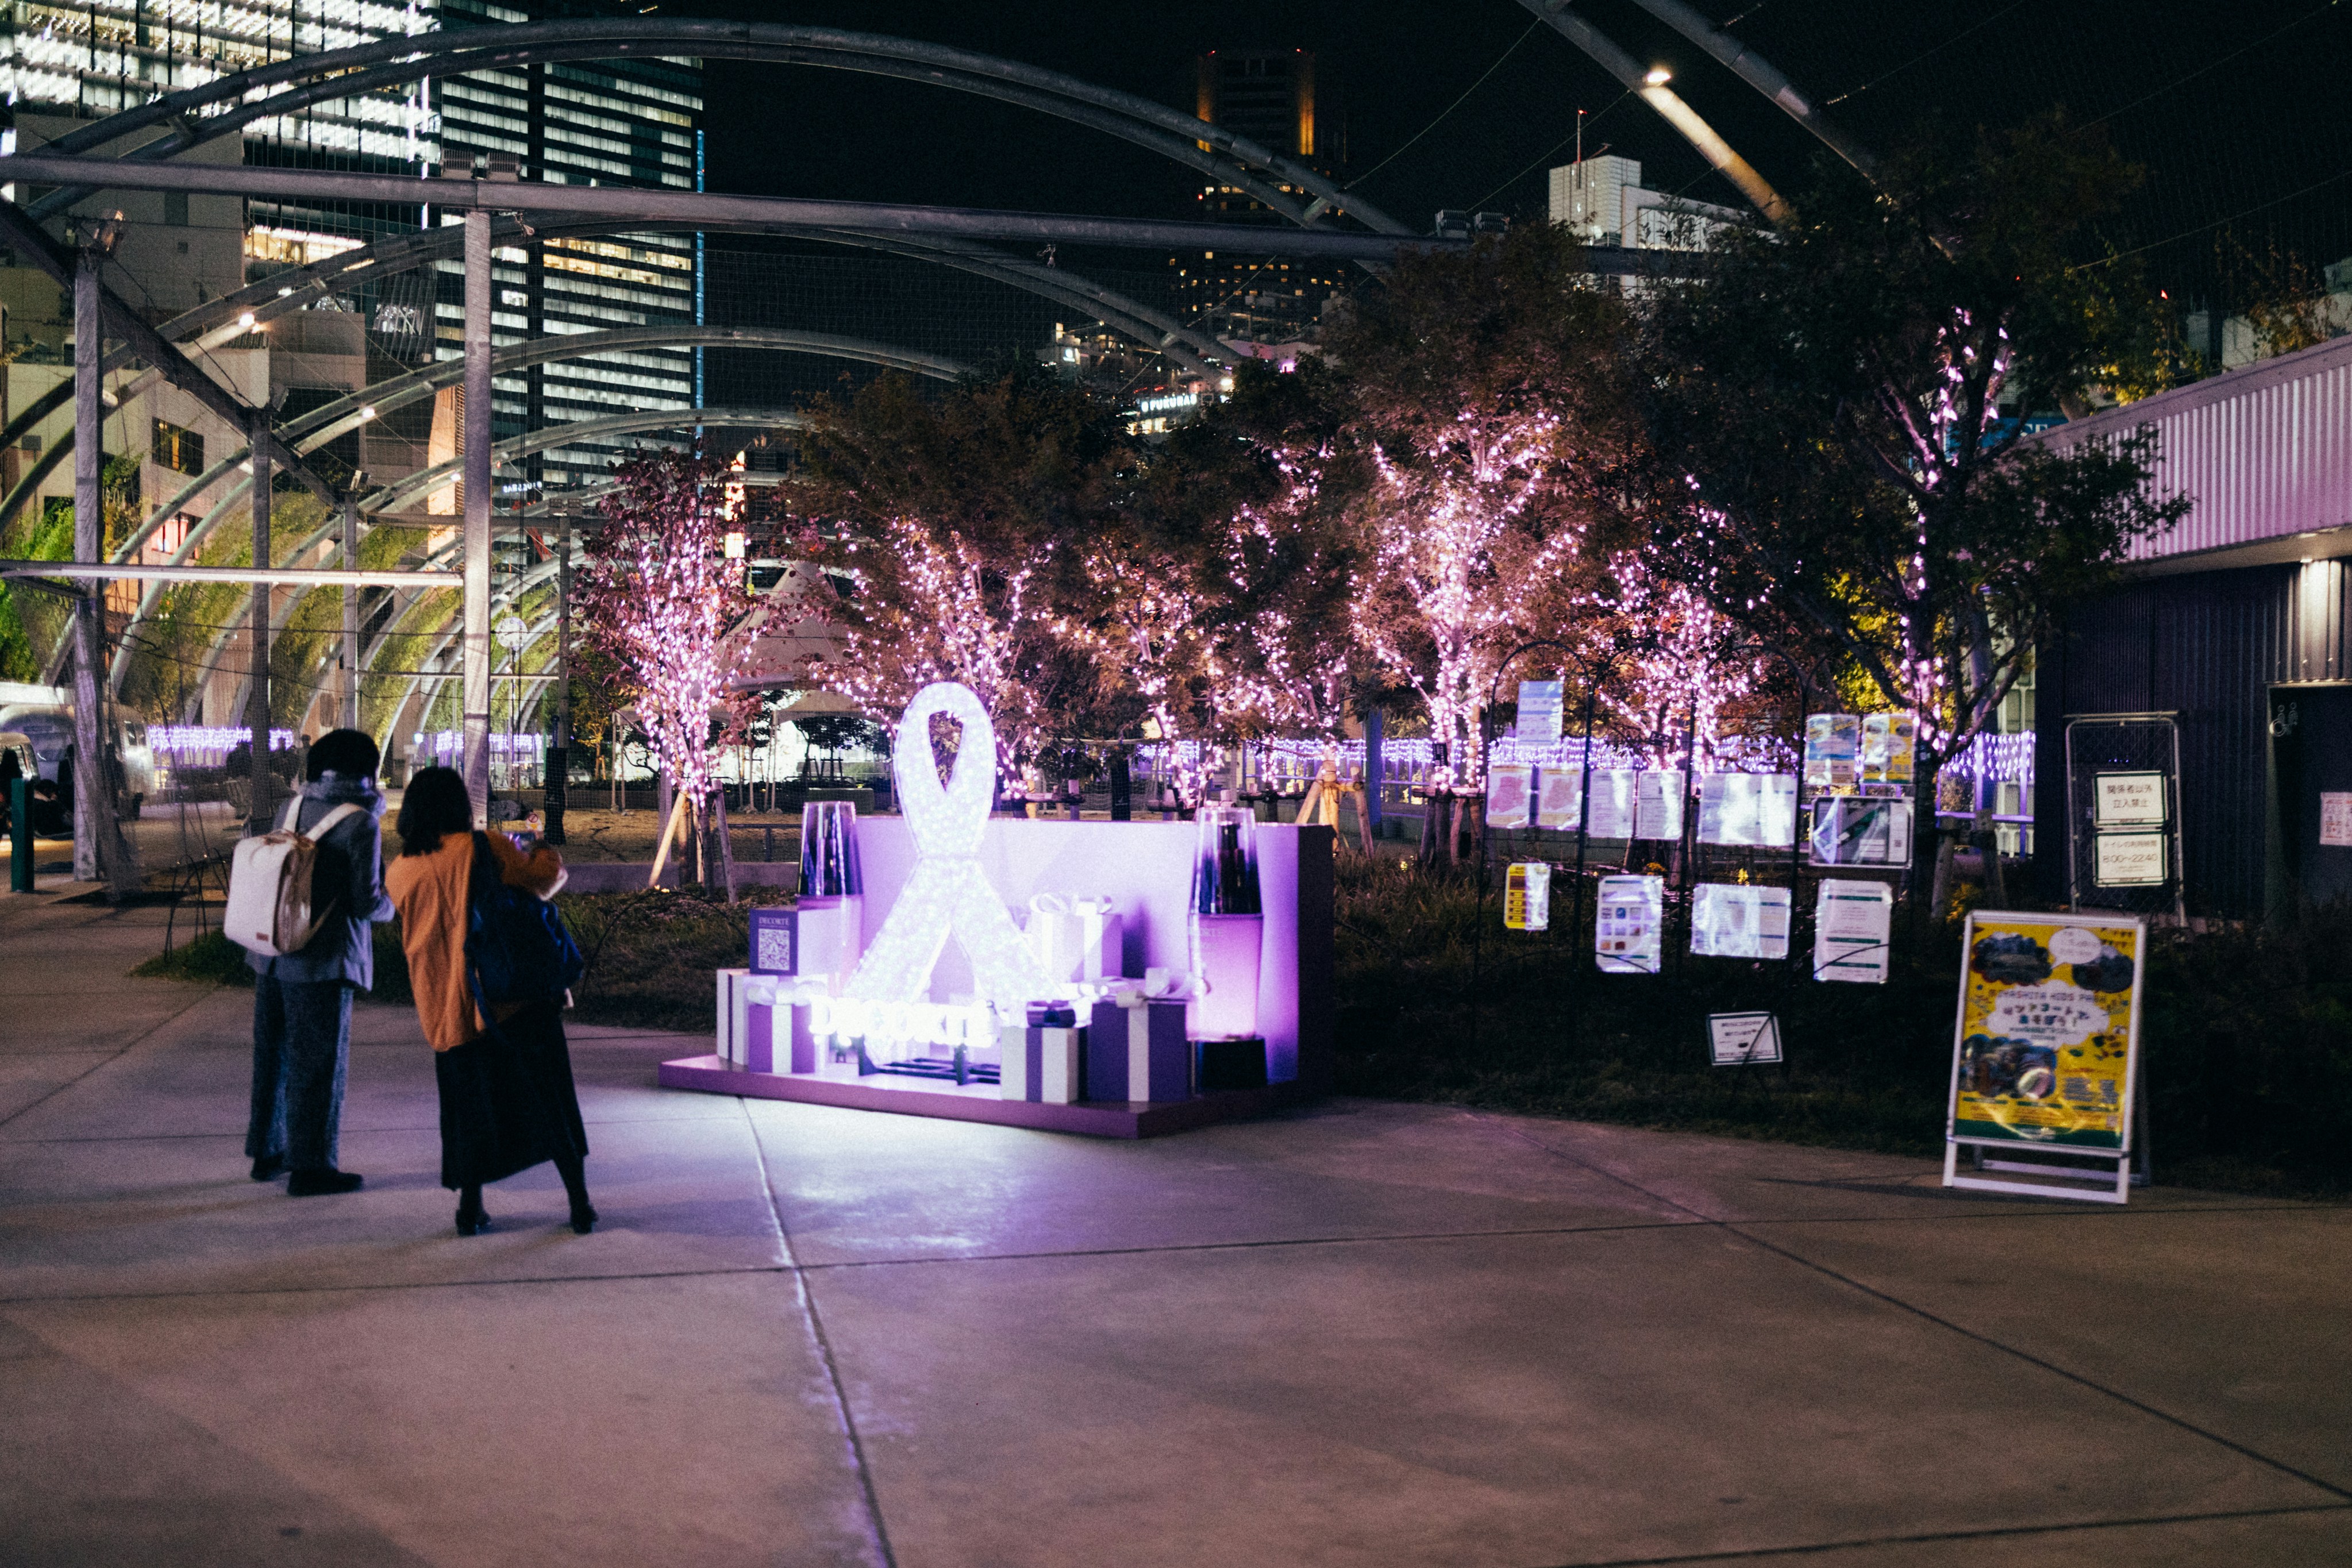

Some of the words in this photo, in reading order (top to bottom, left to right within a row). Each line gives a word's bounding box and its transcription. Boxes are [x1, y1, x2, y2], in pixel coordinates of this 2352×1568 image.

[1150, 394, 1197, 411] FUKURAS
[2107, 784, 2153, 795] 関係者以外
[2113, 799, 2150, 808] 立入禁止
